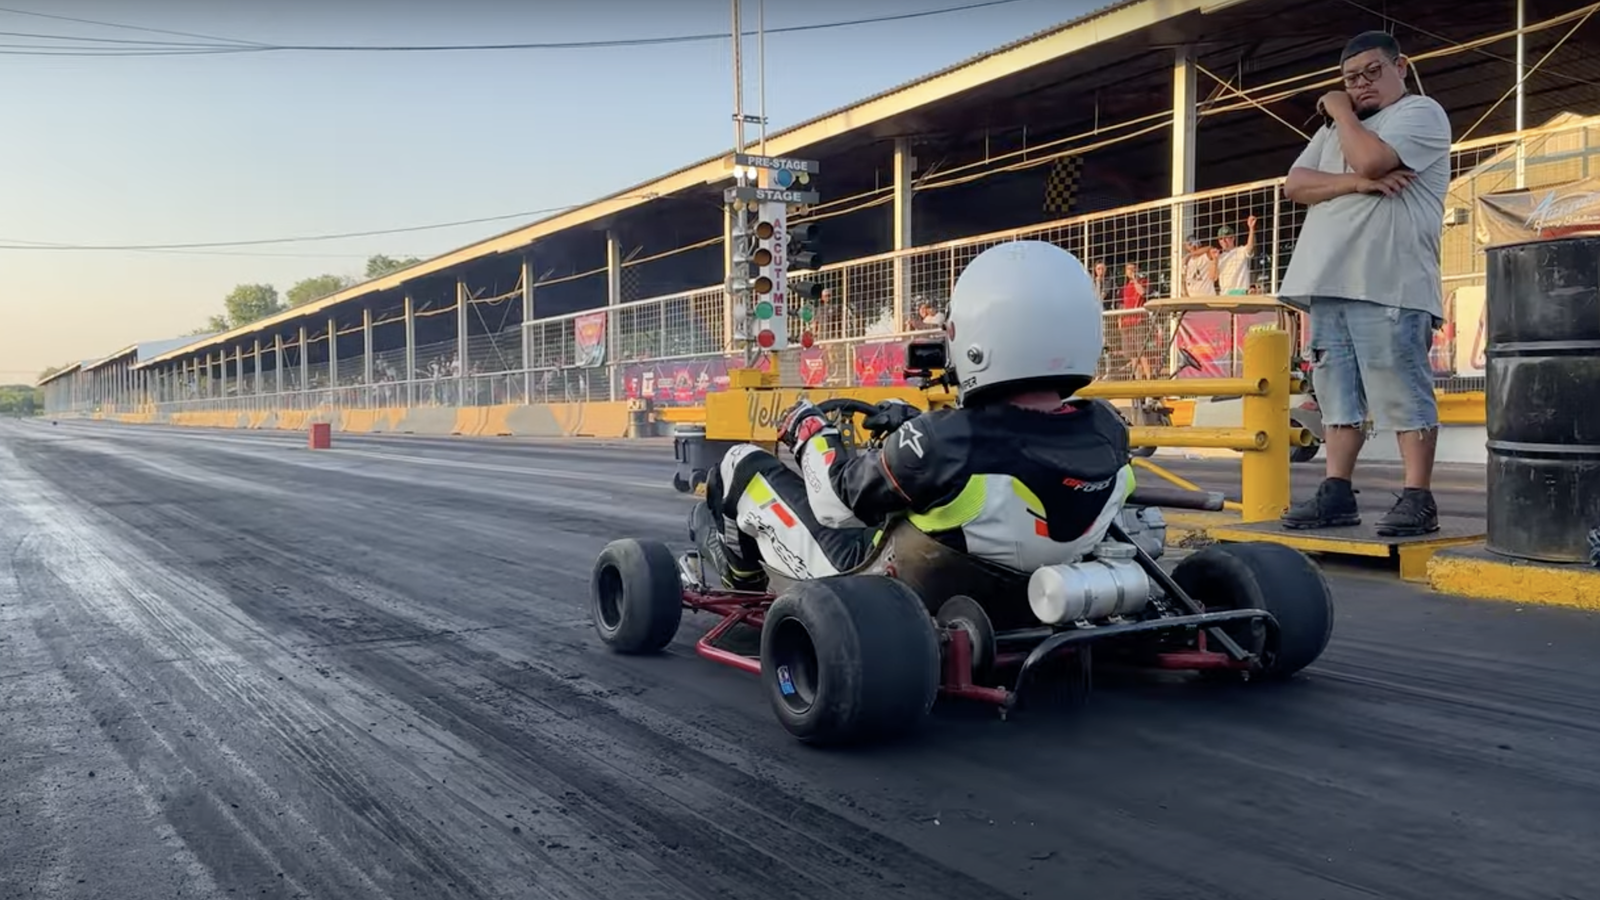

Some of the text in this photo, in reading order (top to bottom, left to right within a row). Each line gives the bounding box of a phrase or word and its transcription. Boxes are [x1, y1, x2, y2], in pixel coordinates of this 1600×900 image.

[748, 156, 808, 171] PRE-STAGE
[756, 189, 802, 201] STAGE
[772, 218, 783, 317] ACCUTIME
